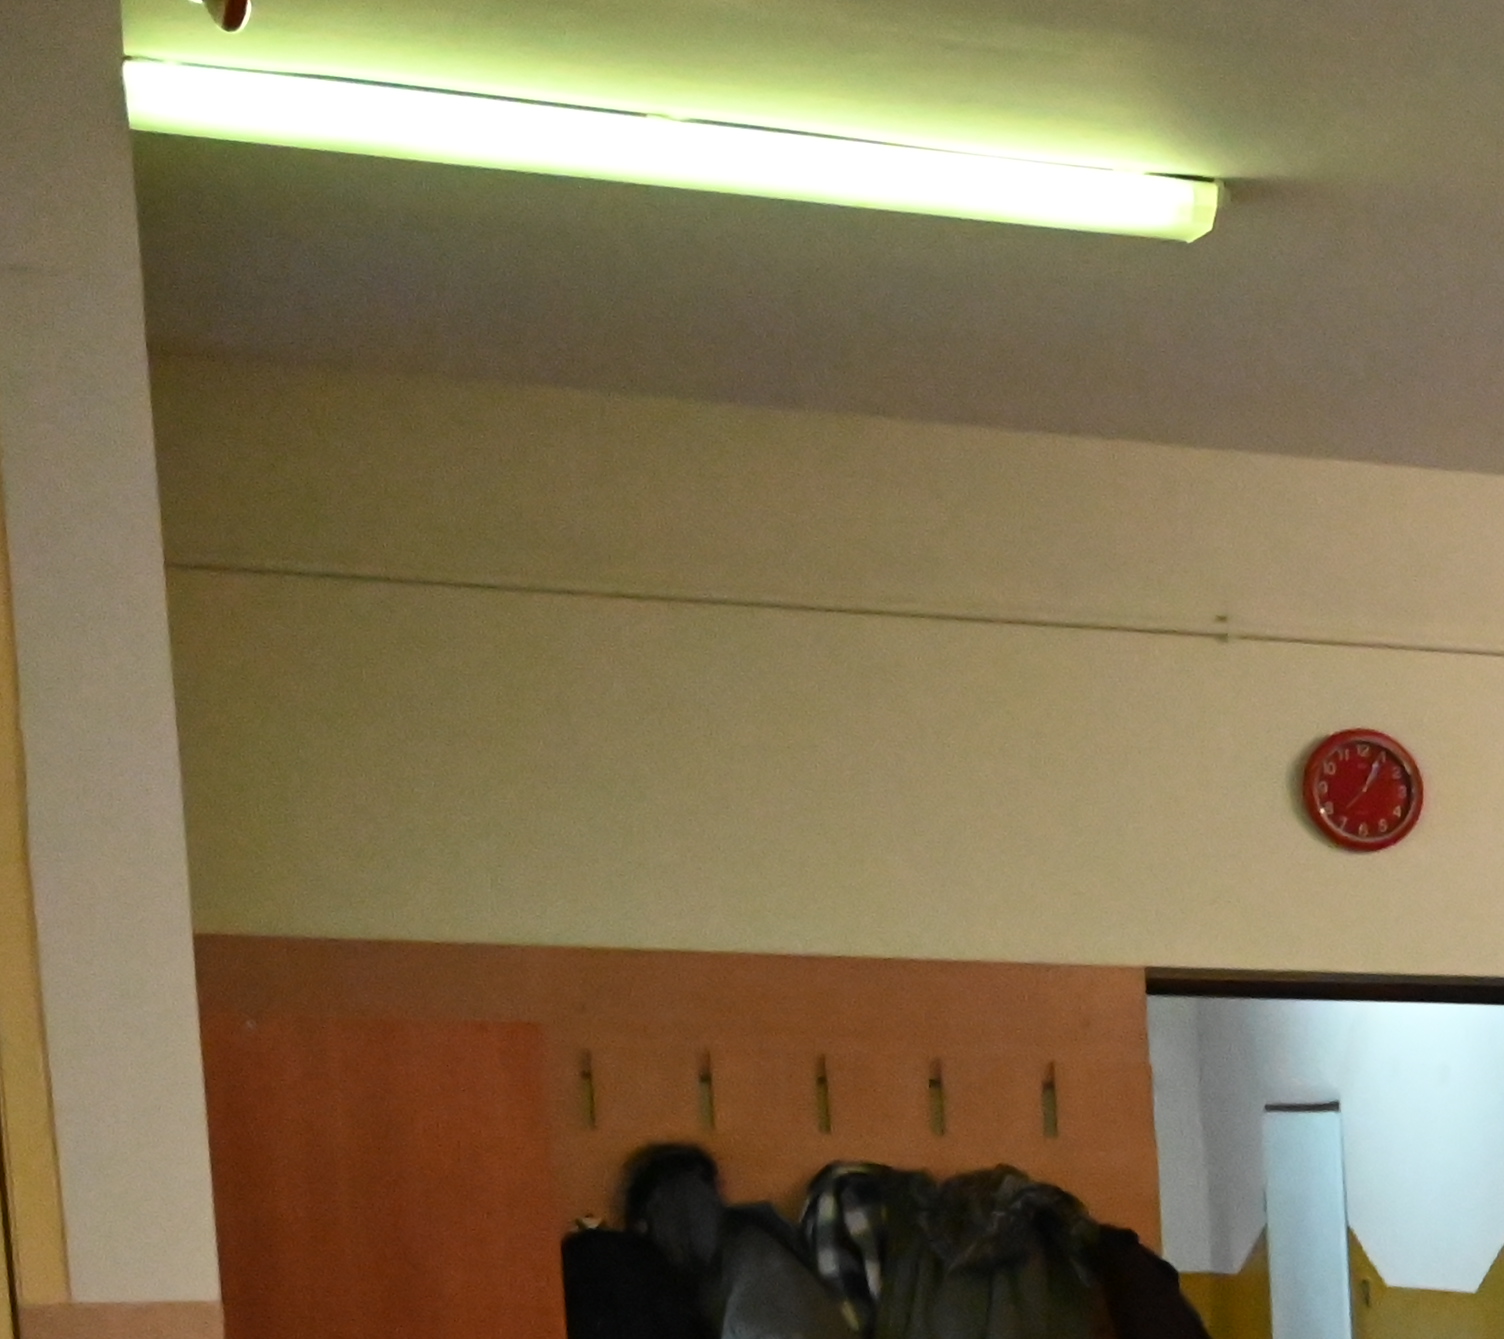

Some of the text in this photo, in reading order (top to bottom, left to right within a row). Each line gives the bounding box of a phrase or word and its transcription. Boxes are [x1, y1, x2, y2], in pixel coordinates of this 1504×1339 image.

[1338, 748, 1350, 761] 11
[1356, 743, 1370, 757] 12
[1323, 761, 1336, 775] 10
[1392, 765, 1402, 780] 2
[1318, 780, 1328, 795] 9
[1393, 805, 1402, 818] 4
[1358, 822, 1369, 836] 6
